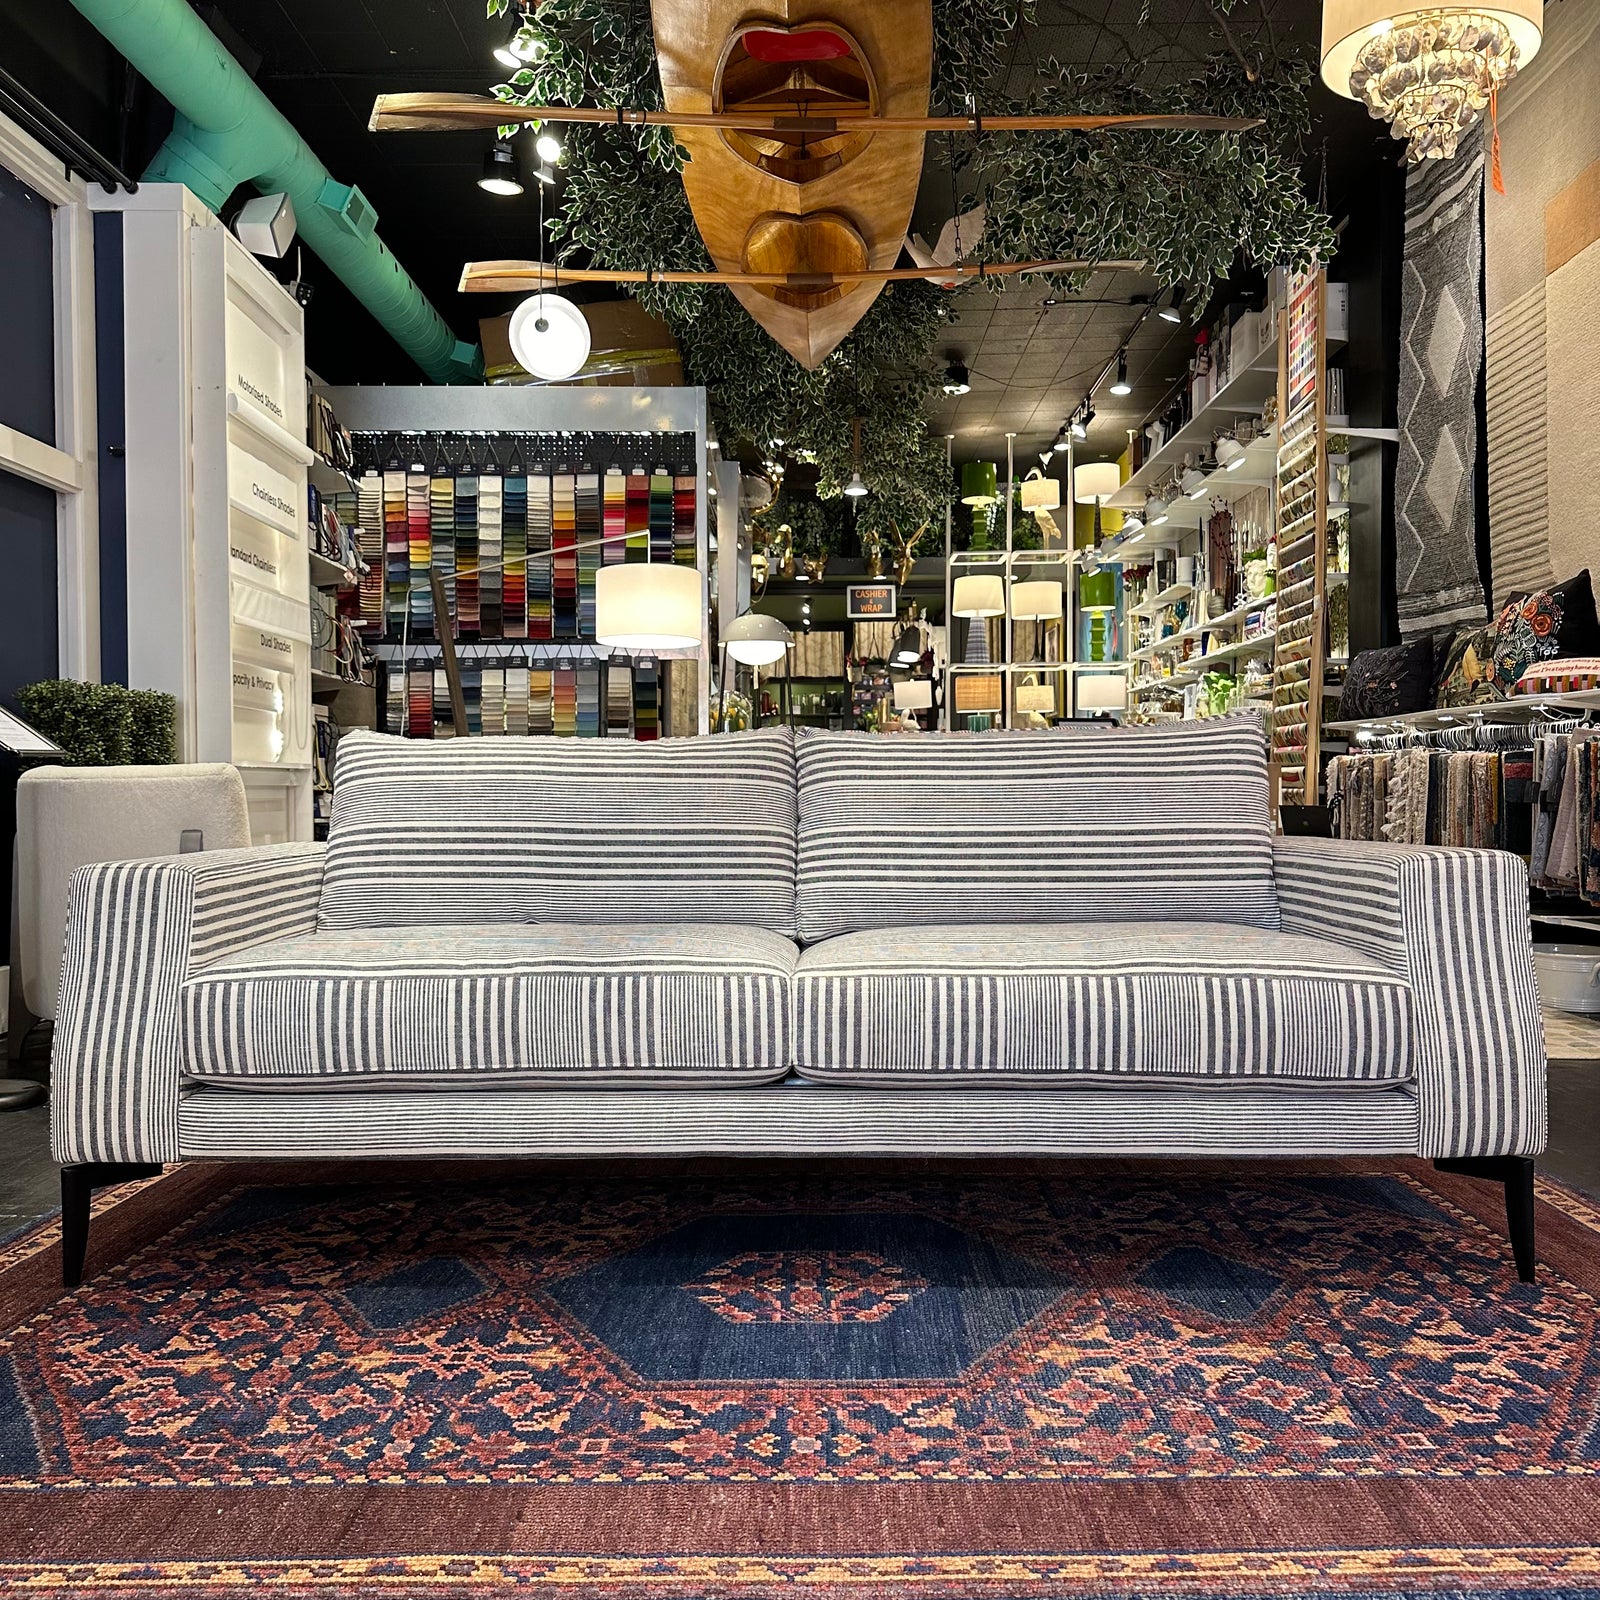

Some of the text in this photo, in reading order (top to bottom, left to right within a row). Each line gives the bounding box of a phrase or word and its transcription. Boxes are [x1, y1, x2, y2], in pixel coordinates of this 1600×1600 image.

[238, 374, 283, 418] Motorized Shades
[252, 483, 277, 507] Chainless
[277, 497, 296, 518] Shades
[253, 554, 276, 575] Chainless
[855, 590, 888, 598] CASHIER
[860, 604, 883, 612] WRAP
[260, 634, 291, 654] Dual Shades
[233, 673, 274, 693] pacity & Privacy
